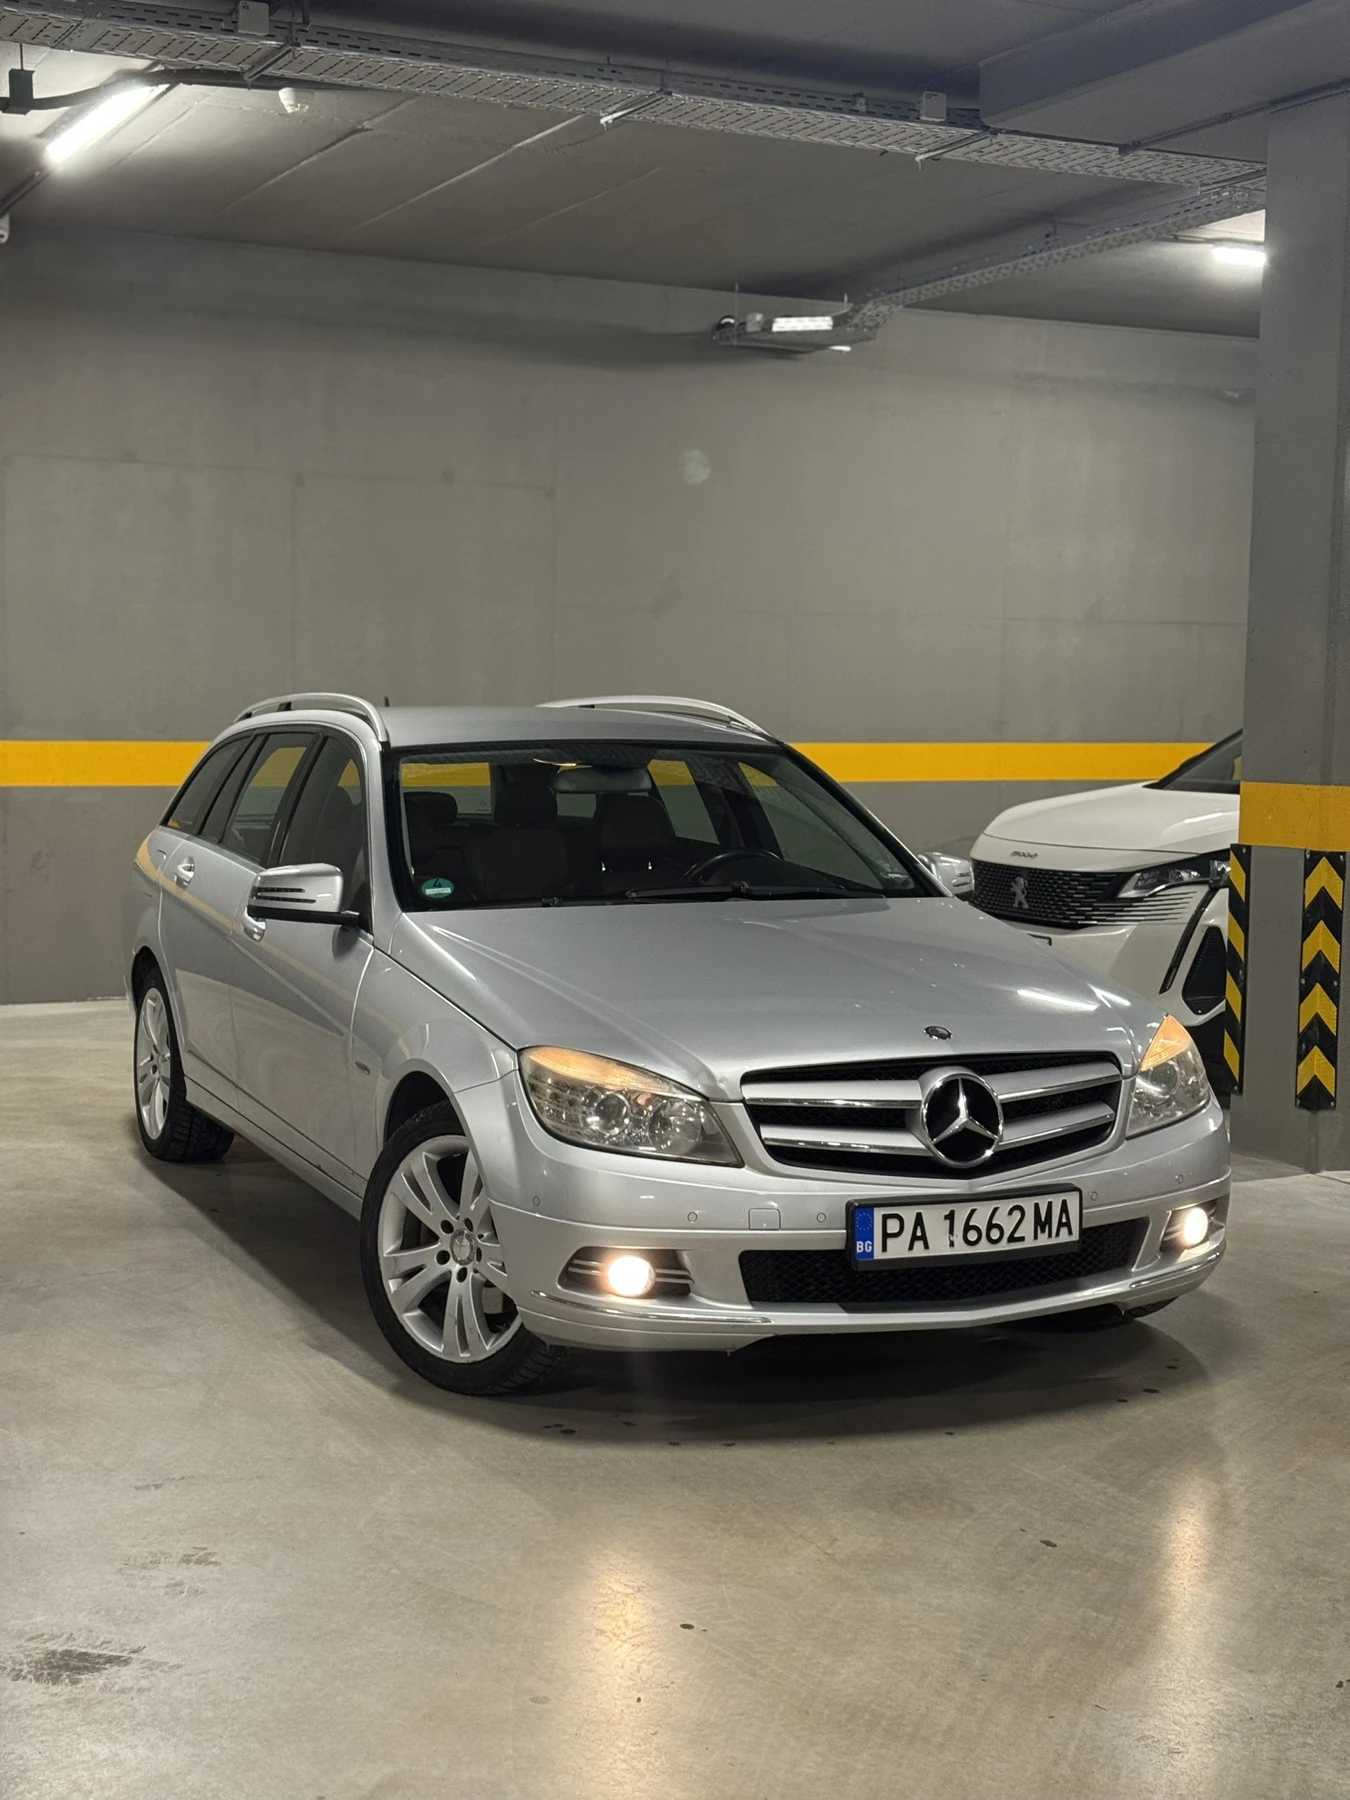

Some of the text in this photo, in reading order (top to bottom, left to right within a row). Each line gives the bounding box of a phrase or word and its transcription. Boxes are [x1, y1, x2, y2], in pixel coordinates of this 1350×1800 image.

[881, 1198, 1074, 1253] PA 1662 MA
[856, 1241, 873, 1253] BG
